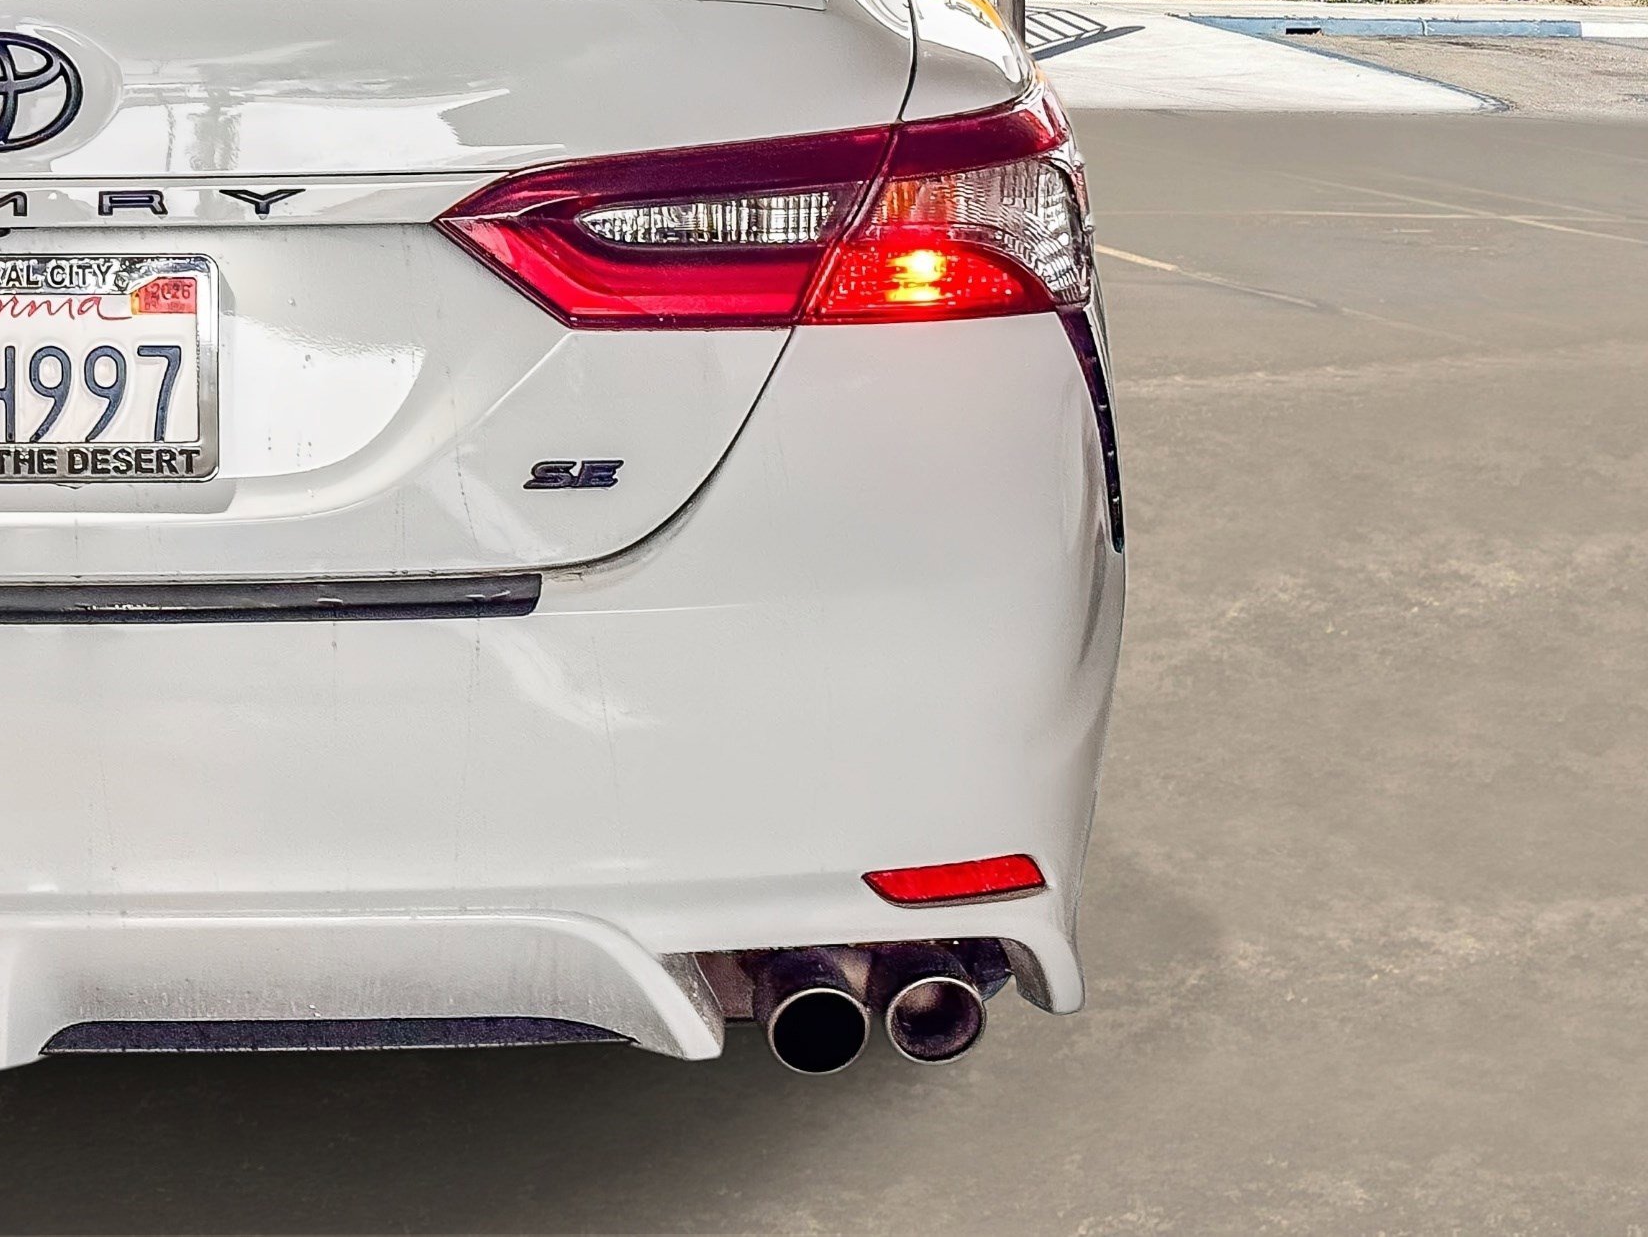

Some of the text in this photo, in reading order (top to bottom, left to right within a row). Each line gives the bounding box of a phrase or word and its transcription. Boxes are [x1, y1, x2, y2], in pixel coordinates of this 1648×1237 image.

[49, 263, 113, 288] CITY
[67, 448, 201, 475] DESERT
[523, 460, 624, 490] SE
